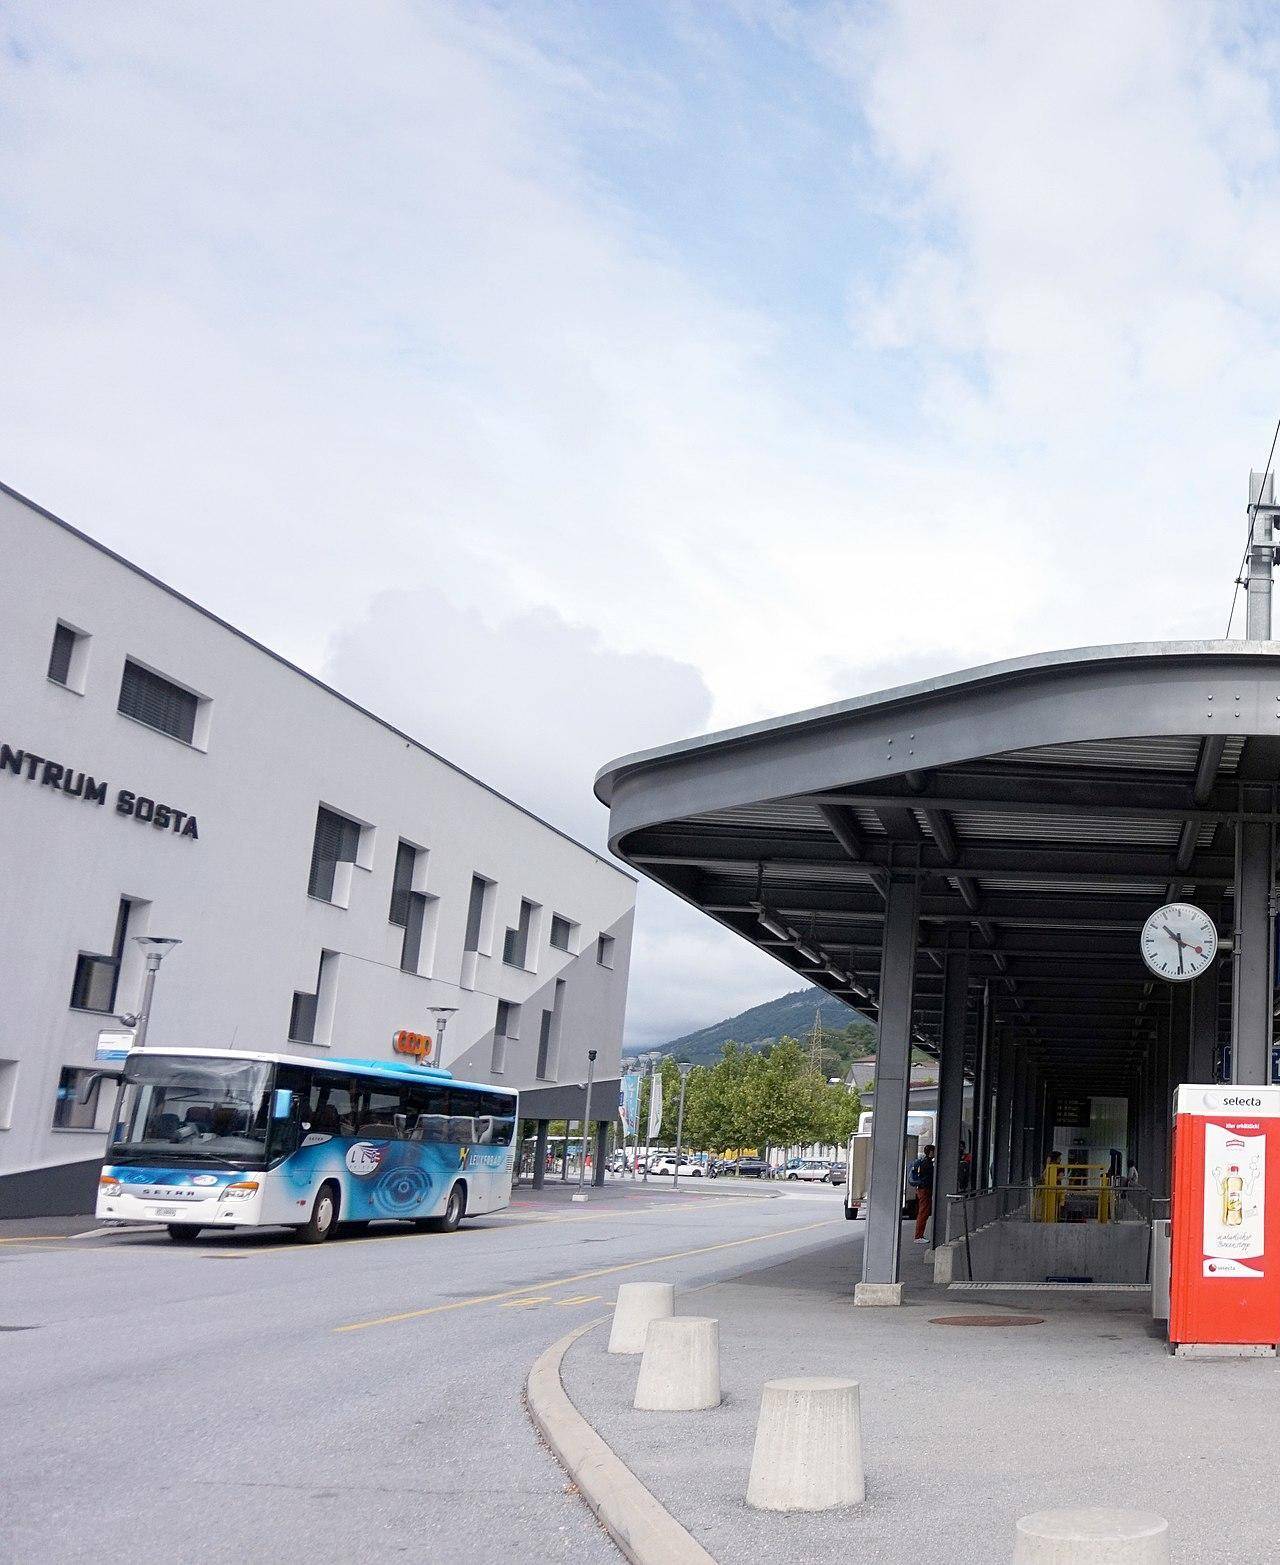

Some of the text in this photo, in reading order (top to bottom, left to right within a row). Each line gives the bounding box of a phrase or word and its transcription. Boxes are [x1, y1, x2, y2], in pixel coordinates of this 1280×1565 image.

[0, 743, 199, 840] NTRUM SOSTA
[1223, 1096, 1261, 1107] selecta
